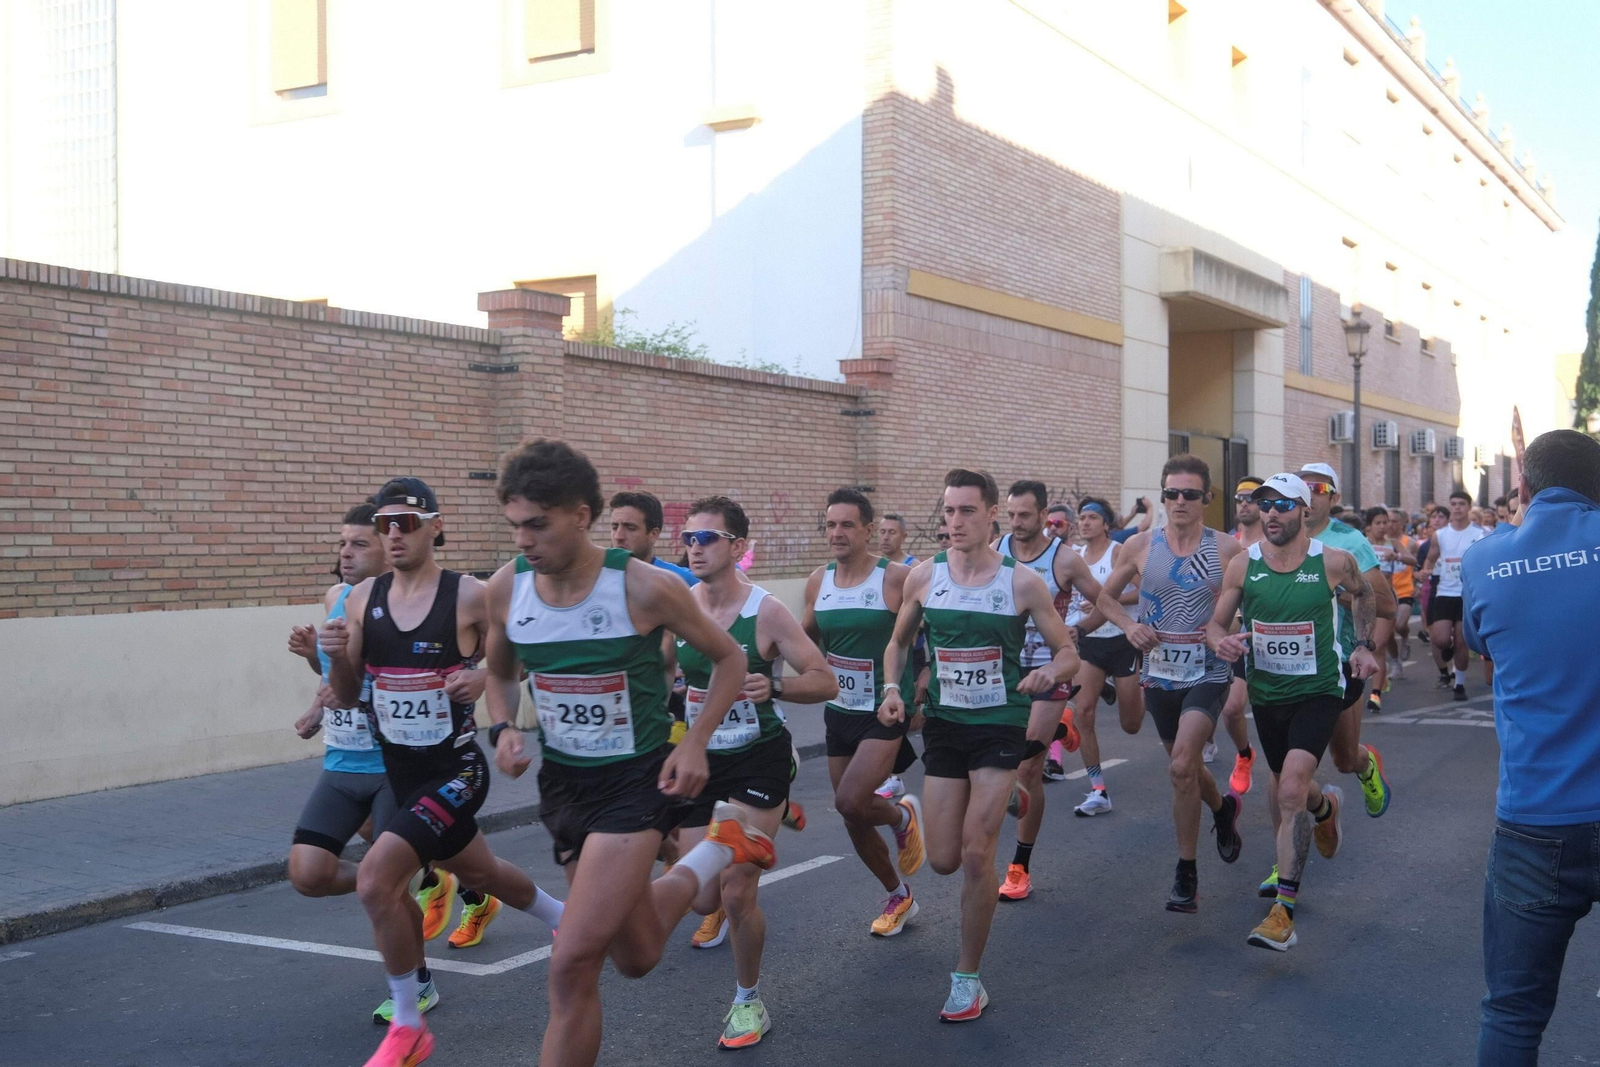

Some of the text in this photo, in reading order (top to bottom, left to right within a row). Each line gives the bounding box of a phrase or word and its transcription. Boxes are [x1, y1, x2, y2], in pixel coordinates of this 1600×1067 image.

[1162, 648, 1192, 664] 177
[1266, 641, 1300, 656] 669
[953, 668, 988, 687] 278
[389, 699, 431, 719] 224
[557, 703, 606, 726] 289
[330, 710, 353, 728] 84
